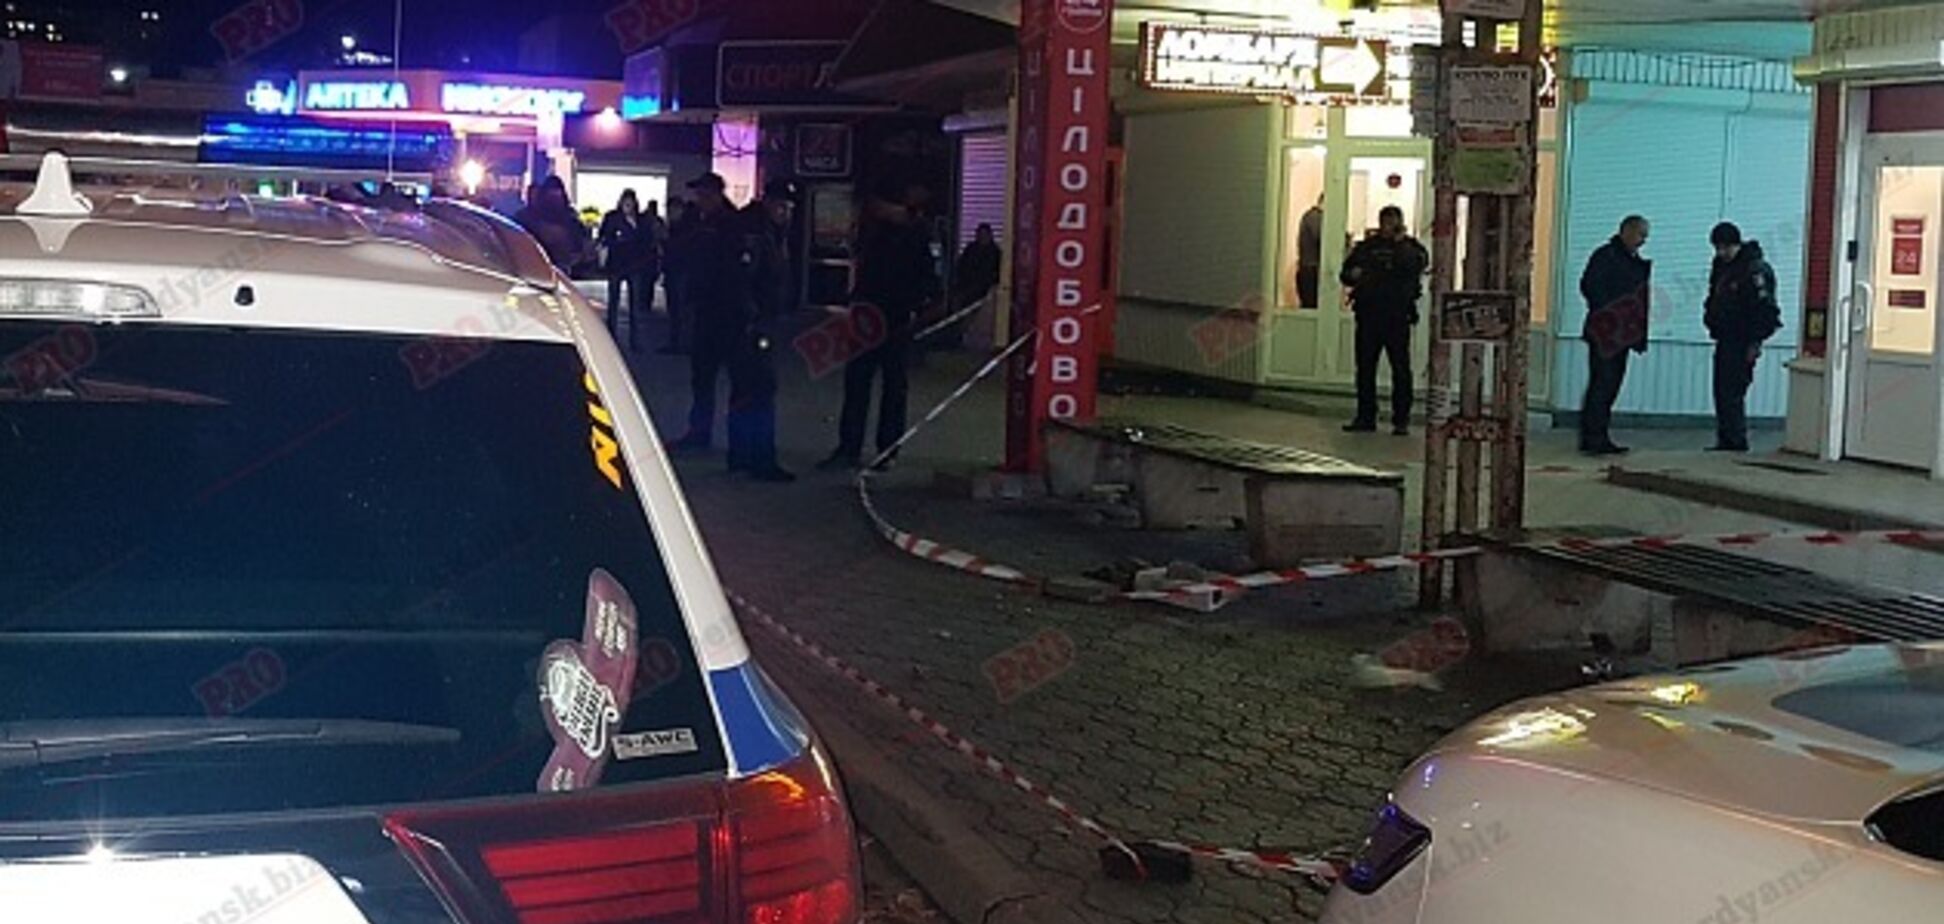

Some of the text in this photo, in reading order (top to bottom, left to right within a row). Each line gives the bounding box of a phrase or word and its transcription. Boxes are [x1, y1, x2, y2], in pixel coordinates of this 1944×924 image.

[1158, 31, 1318, 68] ЛОМБАРД
[306, 83, 408, 108] АПТЕКА
[1049, 48, 1095, 419] ЦІЛОДОБОВО
